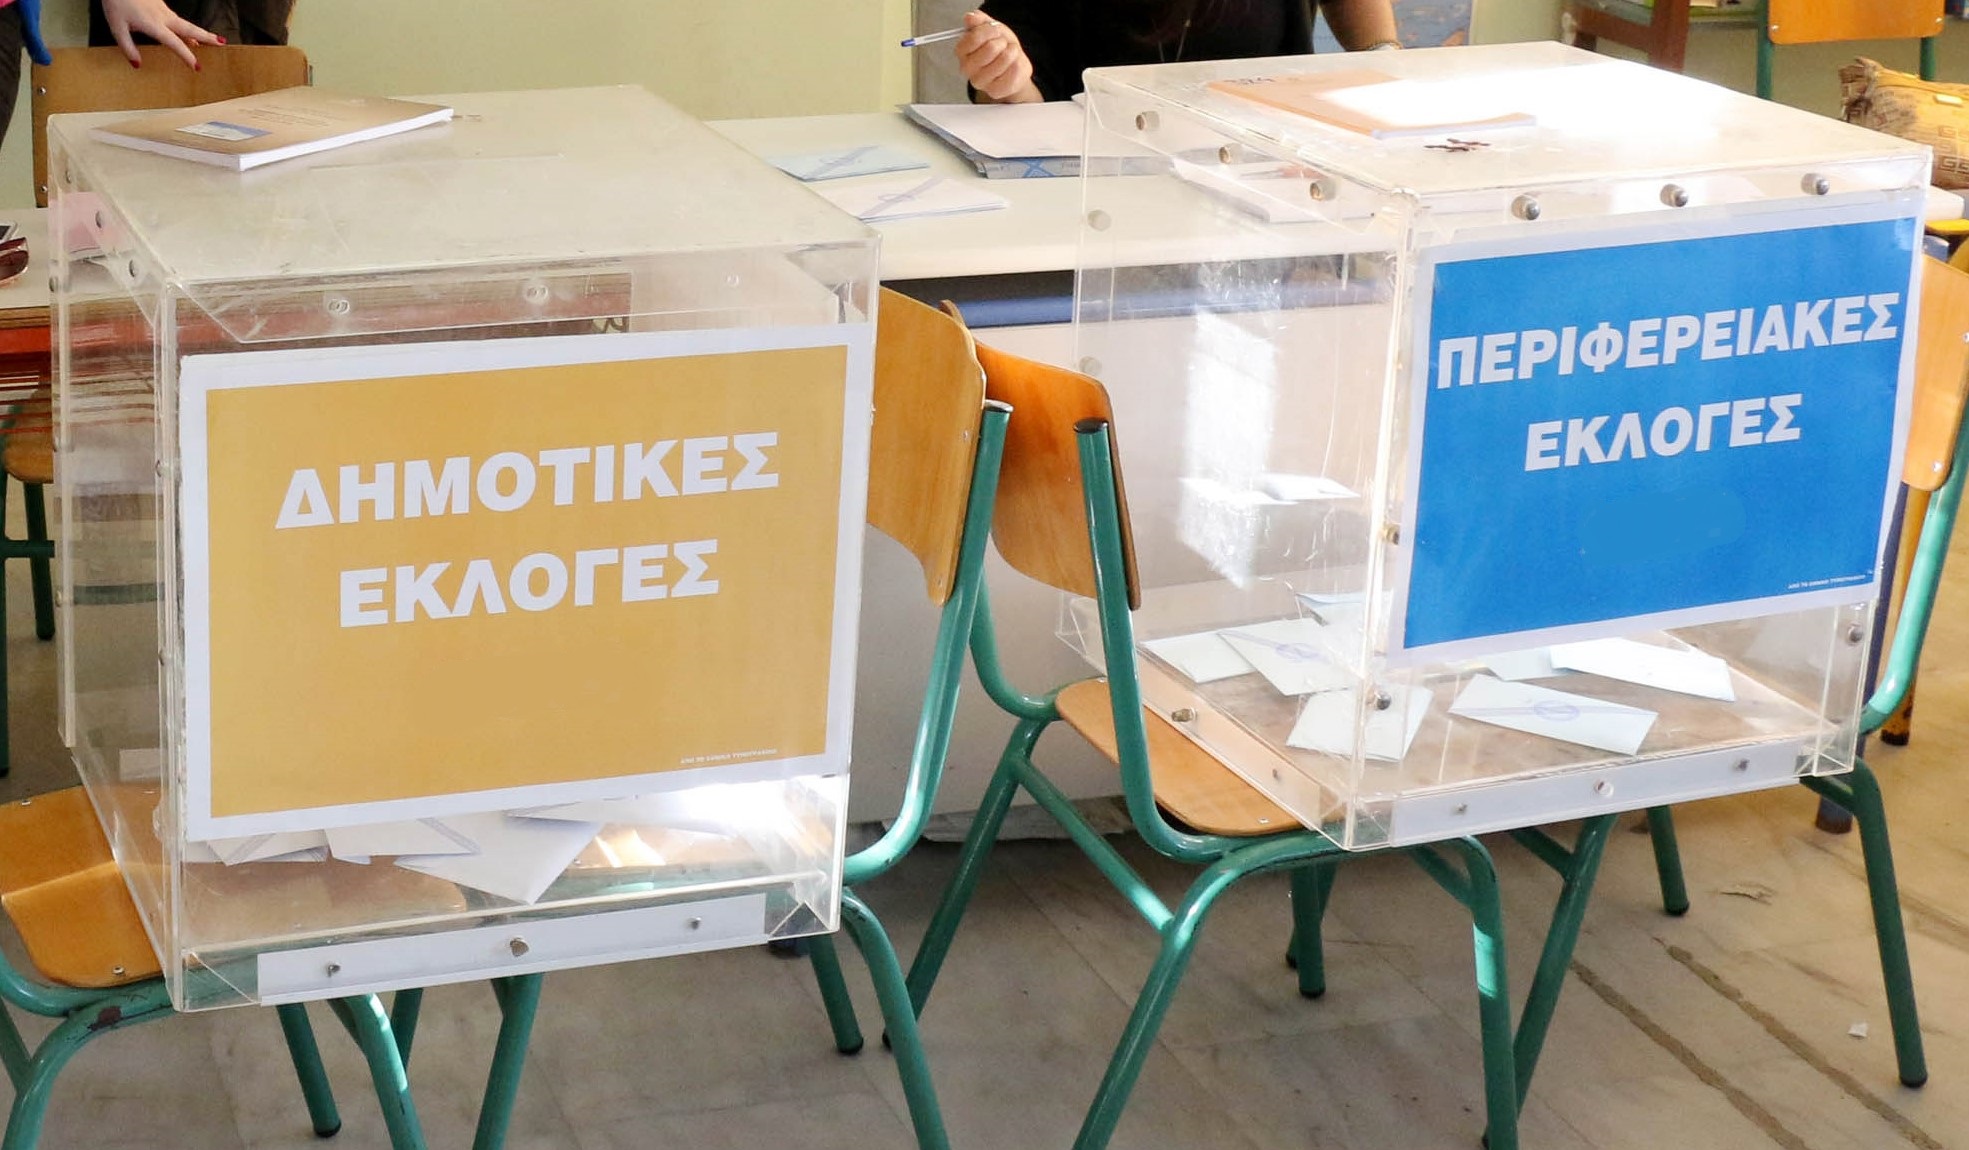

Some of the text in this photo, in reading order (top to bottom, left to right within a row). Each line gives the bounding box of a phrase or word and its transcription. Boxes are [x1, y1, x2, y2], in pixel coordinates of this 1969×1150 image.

[1437, 292, 1900, 389] ΠΕΡΙΦΕΡΕΙΑΚΕΣ
[1525, 393, 1802, 471] ΕΚΛΟΓΕΣ
[274, 430, 781, 530] ΔΗΜΟΤΙΚΕΣ
[339, 537, 721, 629] ΕΚΛΟΓΕΣ
